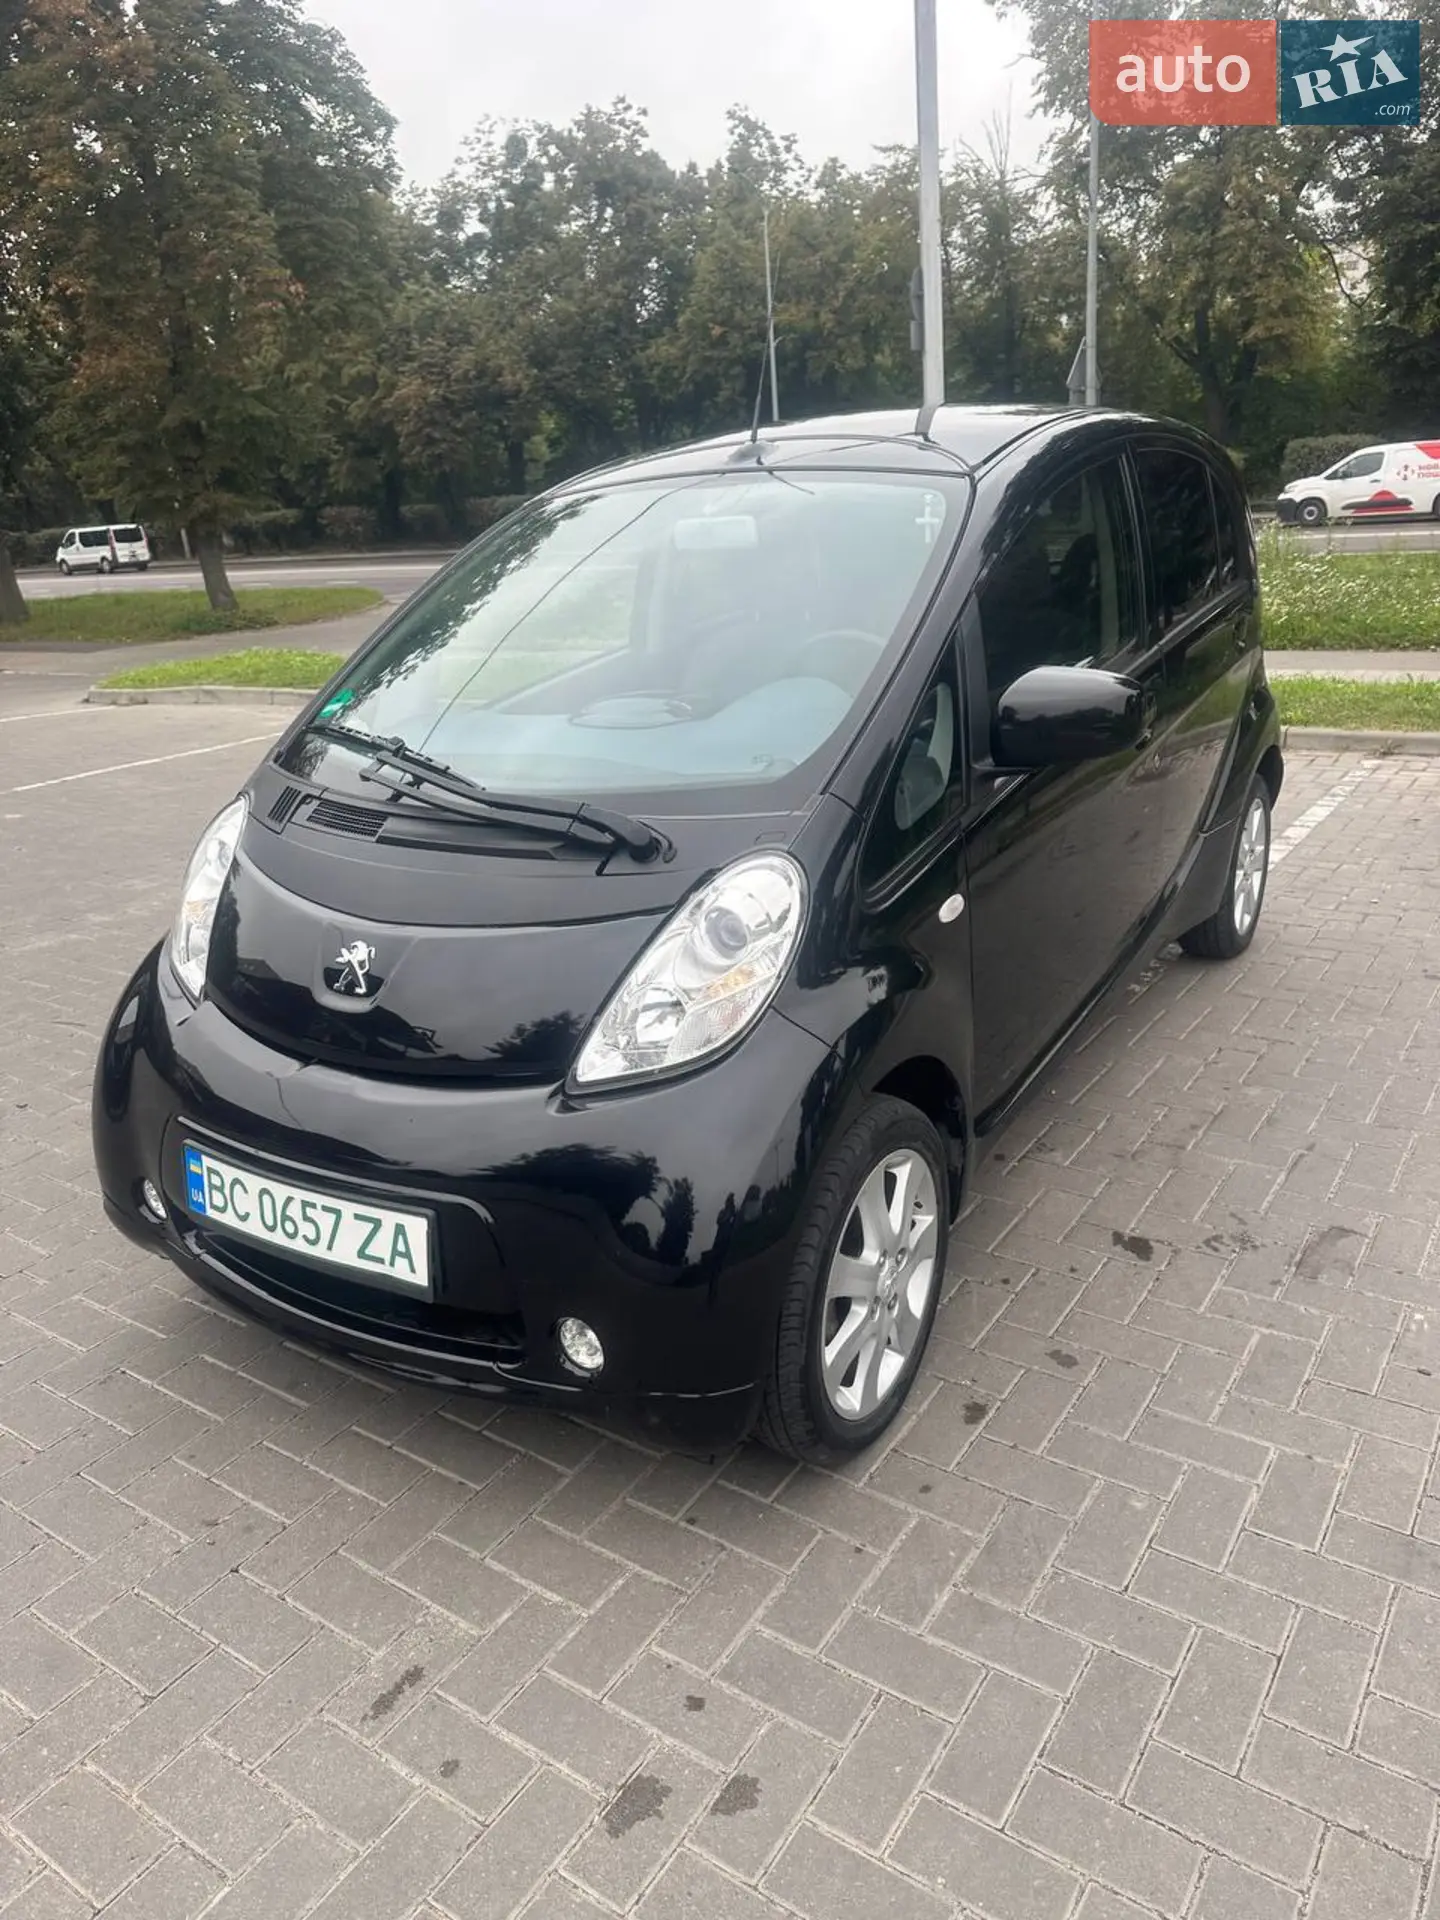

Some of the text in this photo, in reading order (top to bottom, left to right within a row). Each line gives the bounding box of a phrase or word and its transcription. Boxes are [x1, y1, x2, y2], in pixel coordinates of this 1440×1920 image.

[191, 1190, 204, 1205] UA
[206, 1166, 416, 1275] BC 0657 ZA
